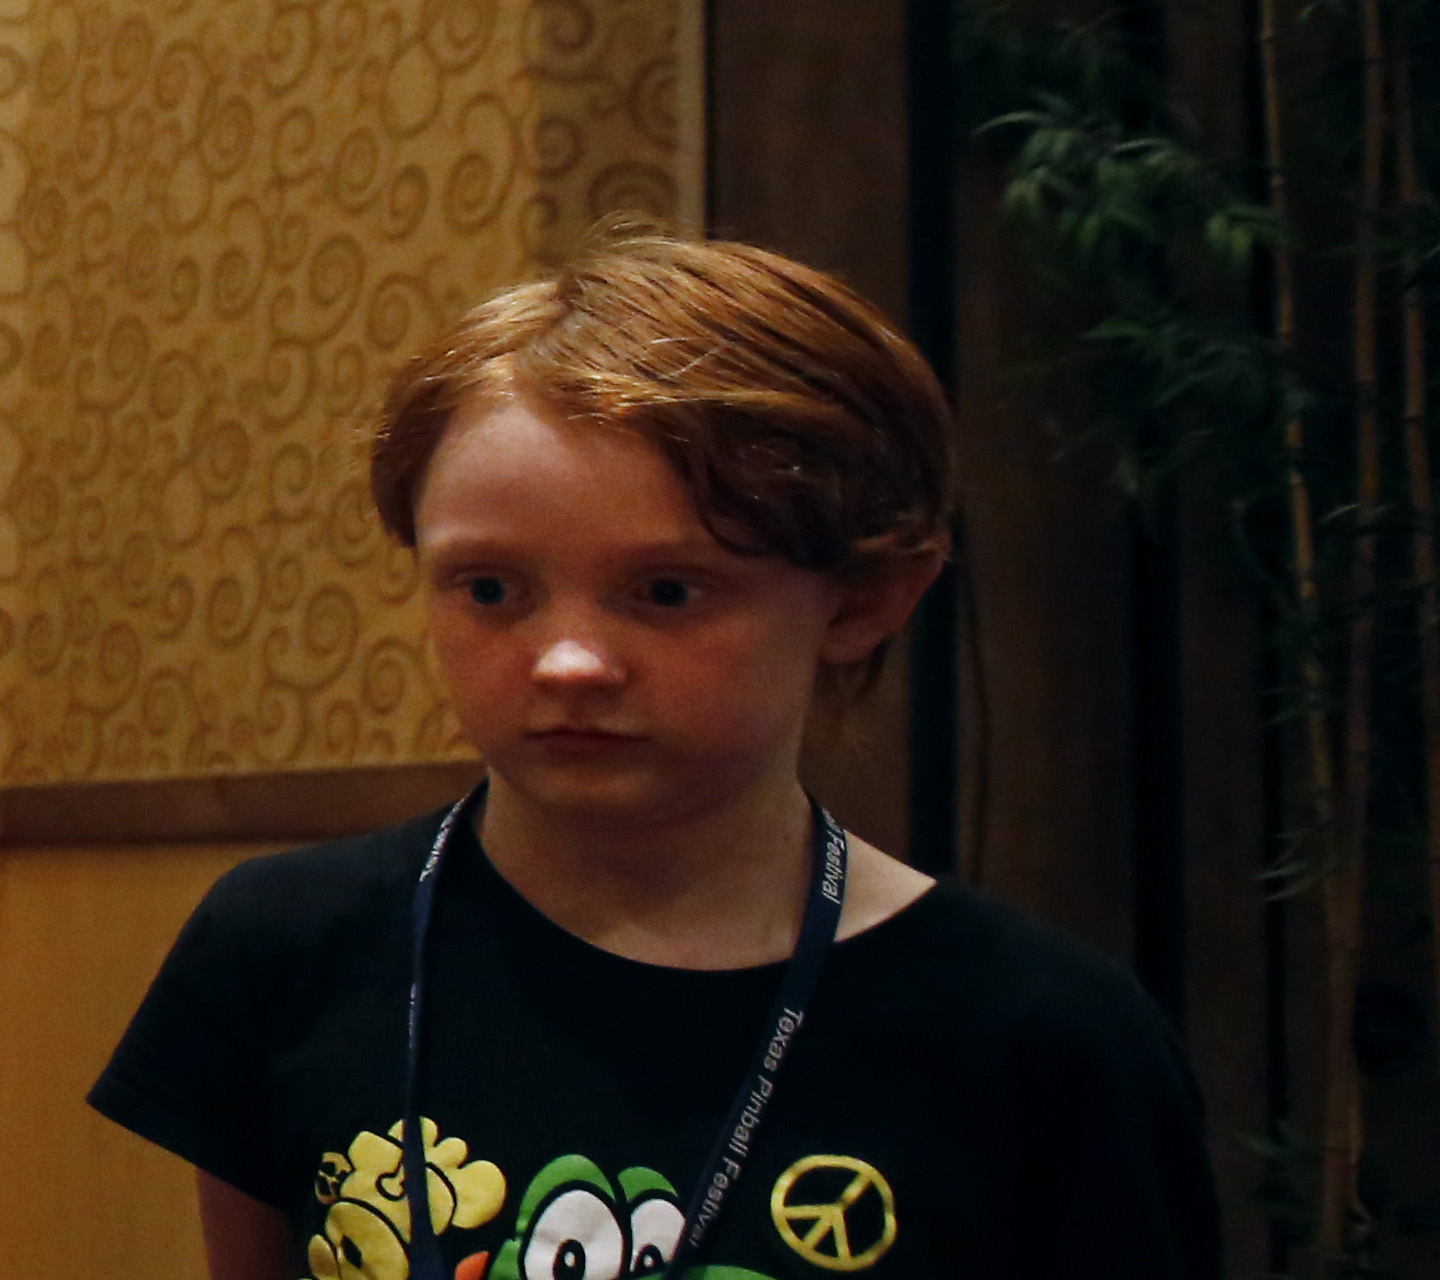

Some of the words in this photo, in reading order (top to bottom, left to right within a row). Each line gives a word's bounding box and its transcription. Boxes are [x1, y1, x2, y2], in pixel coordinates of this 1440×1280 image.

[821, 830, 845, 905] Festival
[763, 1006, 805, 1072] Texas
[730, 1074, 774, 1157] Pinball
[688, 1161, 742, 1248] Festival
